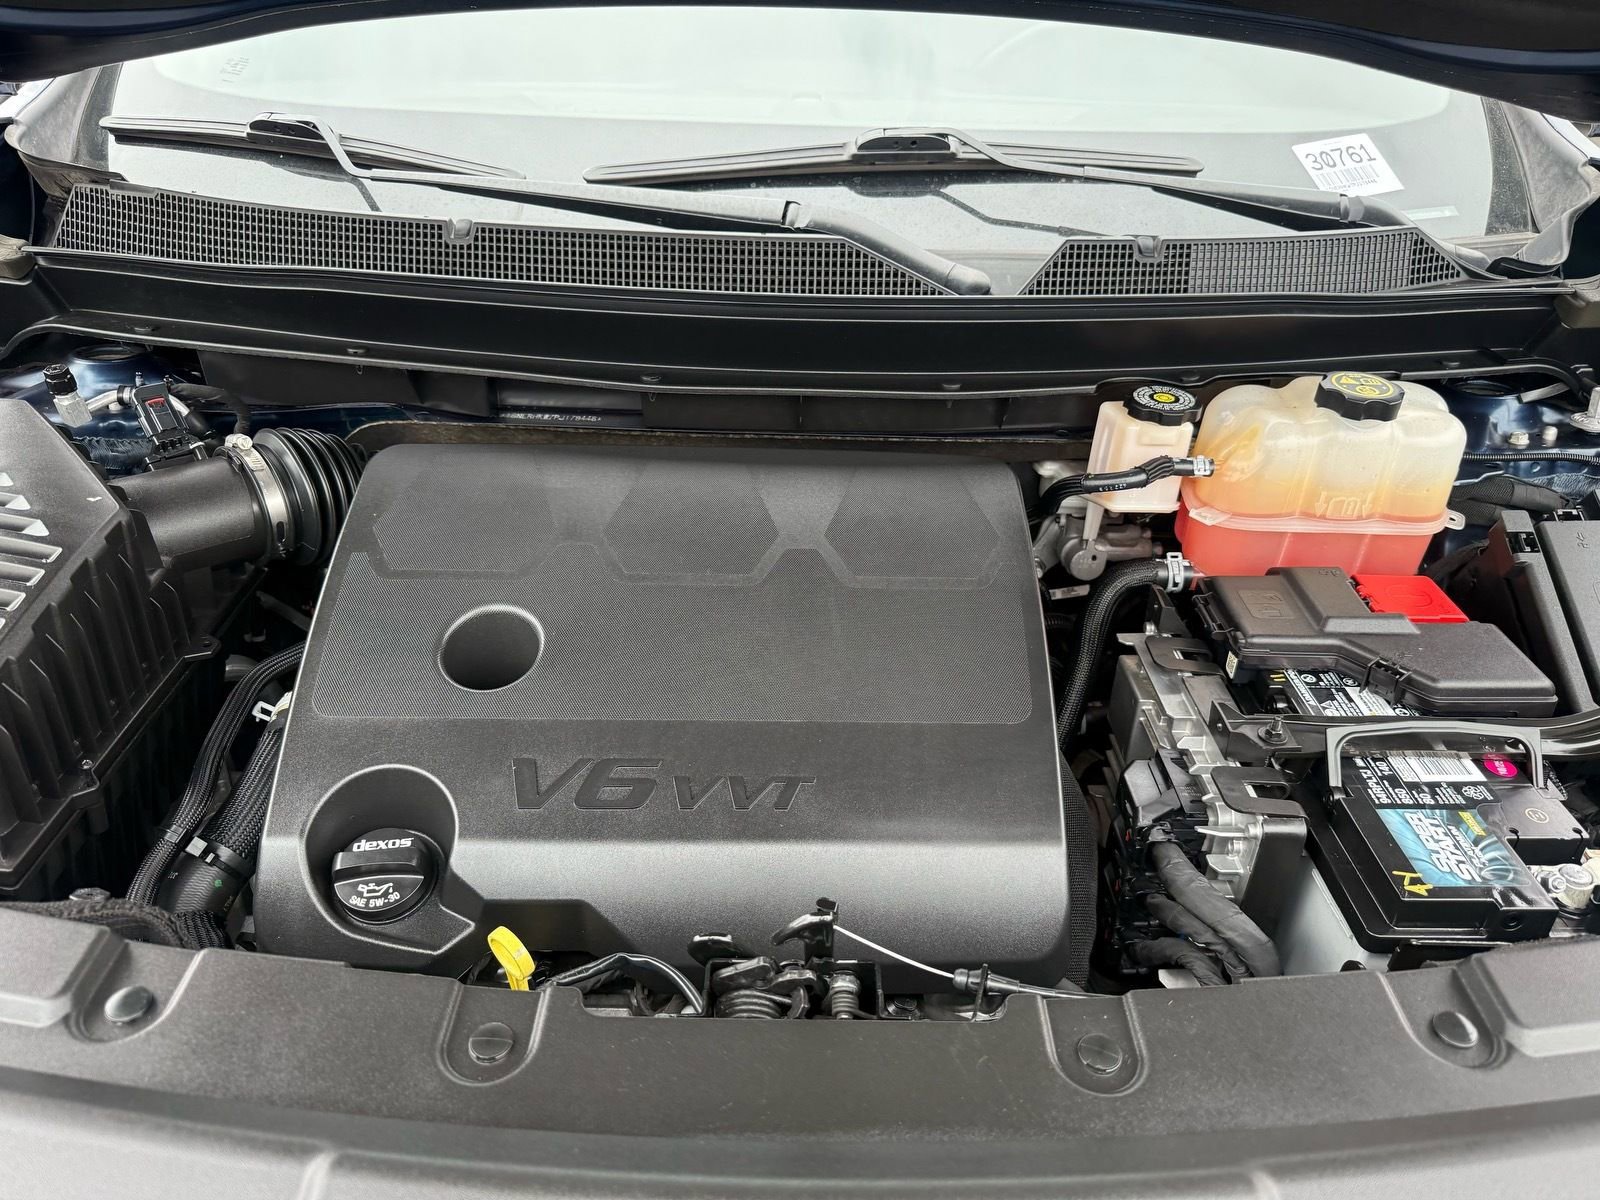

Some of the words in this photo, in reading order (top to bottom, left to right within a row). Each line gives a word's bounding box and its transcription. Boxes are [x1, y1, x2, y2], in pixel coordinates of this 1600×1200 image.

[1305, 144, 1376, 170] 30761
[1375, 761, 1394, 776] 140
[512, 758, 663, 810] V6
[673, 776, 817, 811] VVT
[1394, 787, 1414, 805] 850
[1418, 793, 1435, 805] 80
[352, 838, 414, 852] dexos
[1403, 811, 1453, 873] SUPER
[1416, 811, 1481, 882] START
[349, 895, 367, 907] SAE
[369, 892, 400, 907] 5W-30
